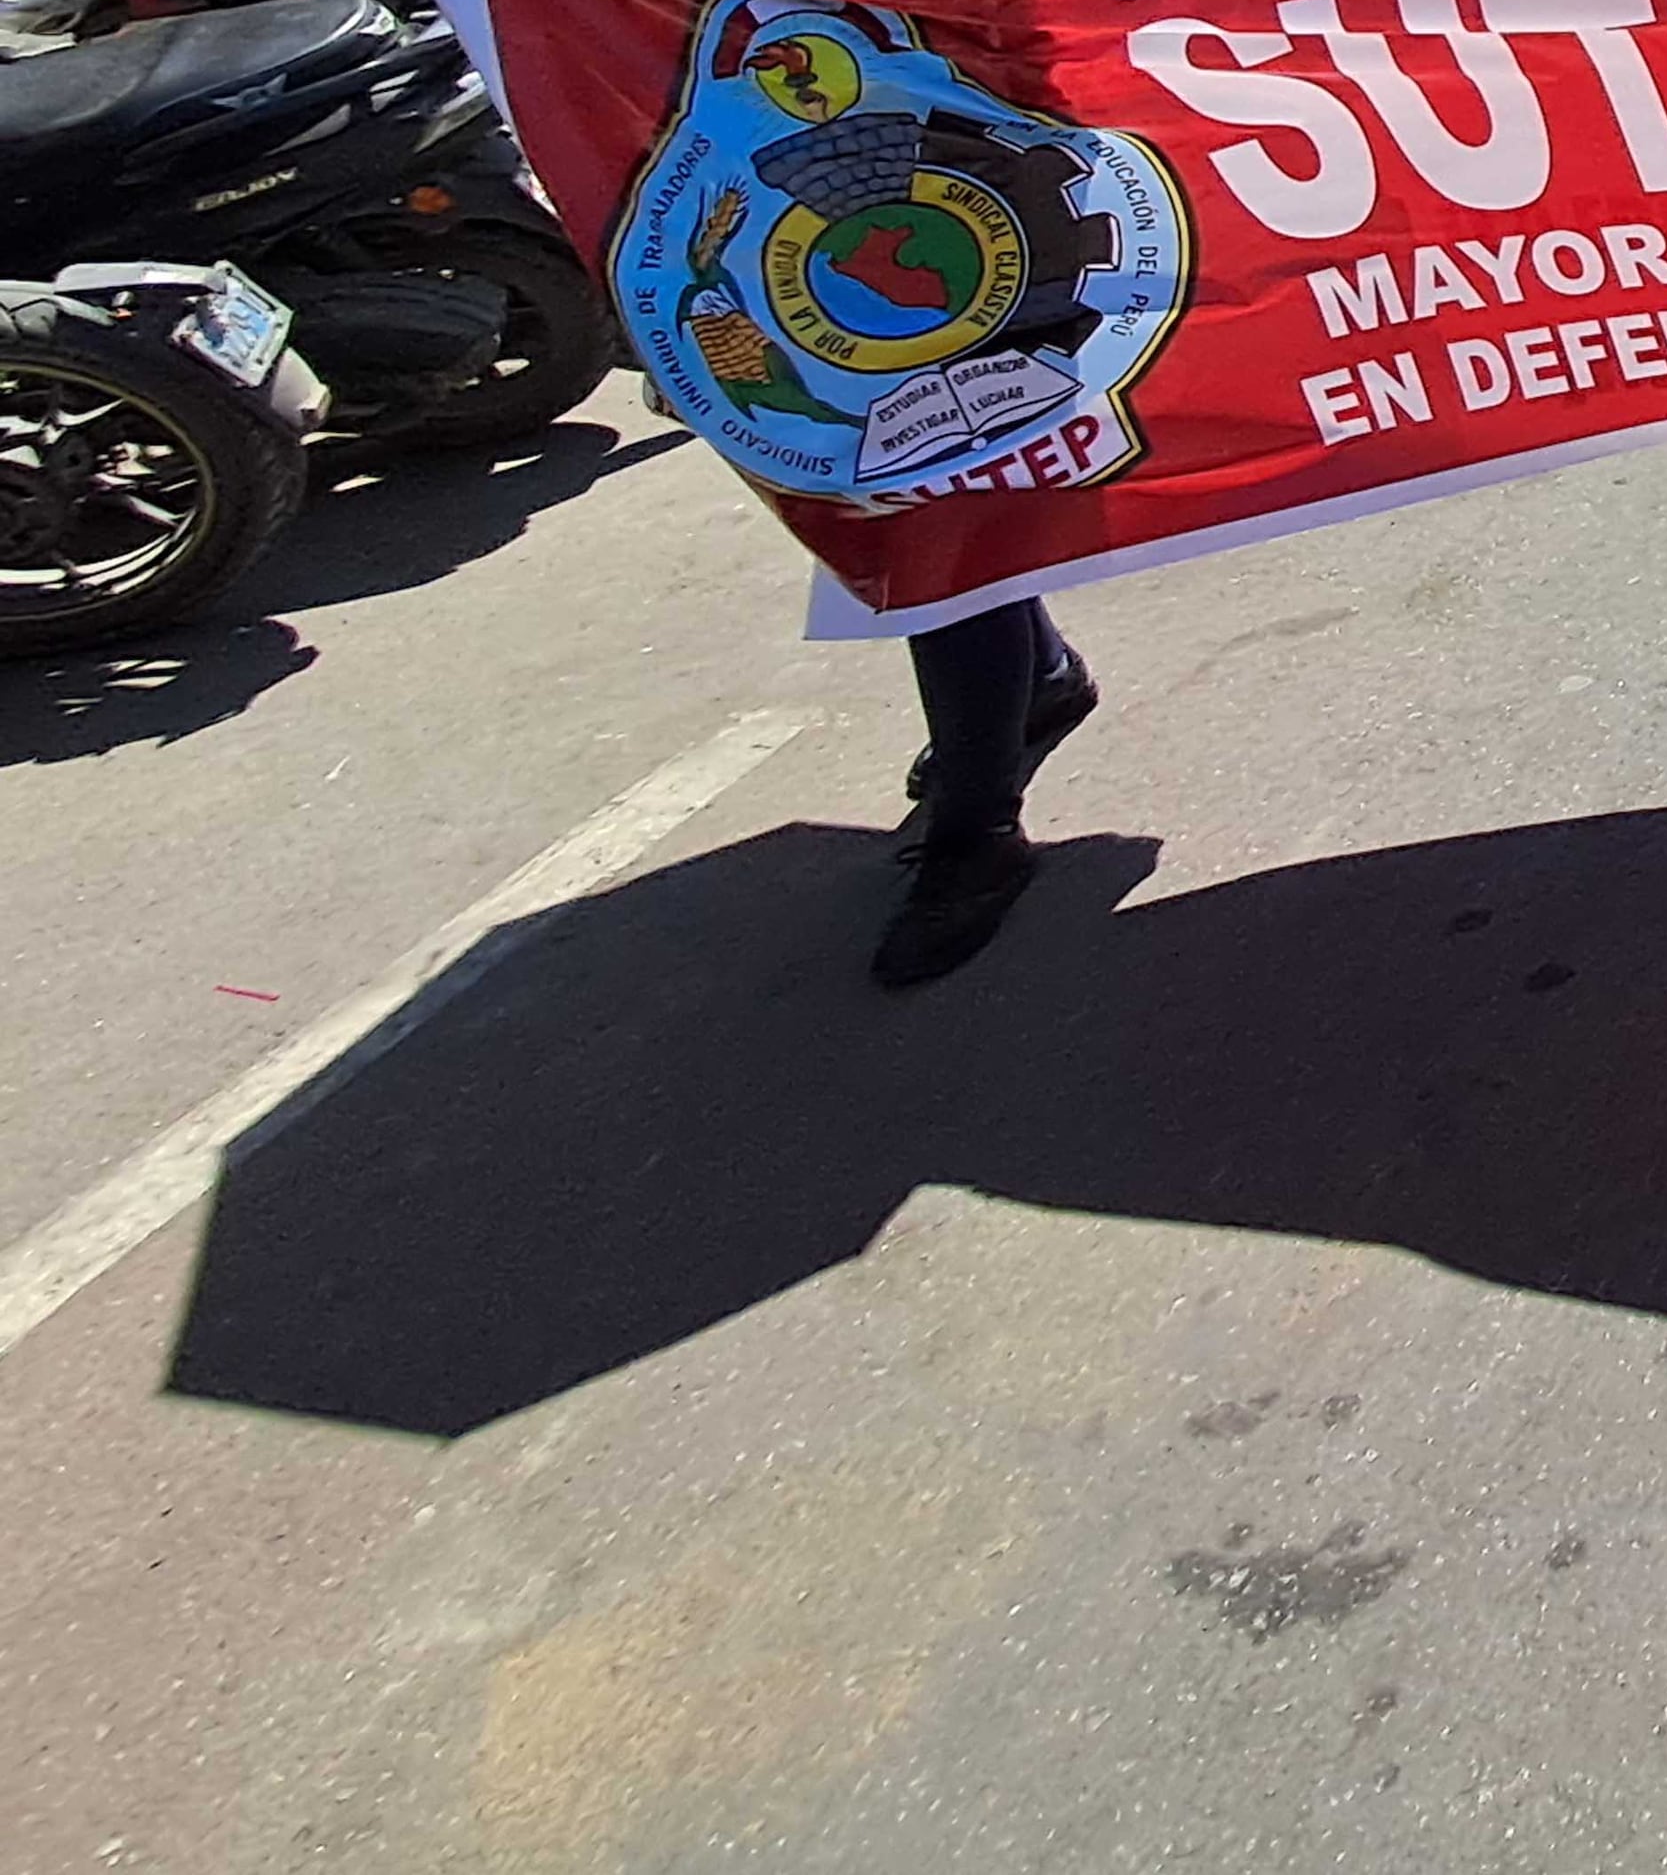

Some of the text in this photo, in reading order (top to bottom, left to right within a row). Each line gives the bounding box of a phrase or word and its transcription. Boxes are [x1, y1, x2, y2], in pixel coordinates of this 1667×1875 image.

[1086, 138, 1158, 232] EDUCACIÓN
[941, 182, 1011, 243] SINDICAL
[1135, 246, 1158, 280] DEL
[639, 286, 657, 315] DE
[966, 250, 1018, 328] CLASISTA
[789, 305, 821, 332] LA
[1110, 292, 1151, 338] PERÚ
[814, 329, 858, 361] POR
[648, 328, 713, 415] UNITARIO
[875, 381, 942, 423] ESTUDIAR
[968, 386, 1026, 414] LUCHAR
[1300, 352, 1434, 447] EN
[719, 418, 837, 477] SINDICATO
[880, 407, 960, 453] INVESTIGAR
